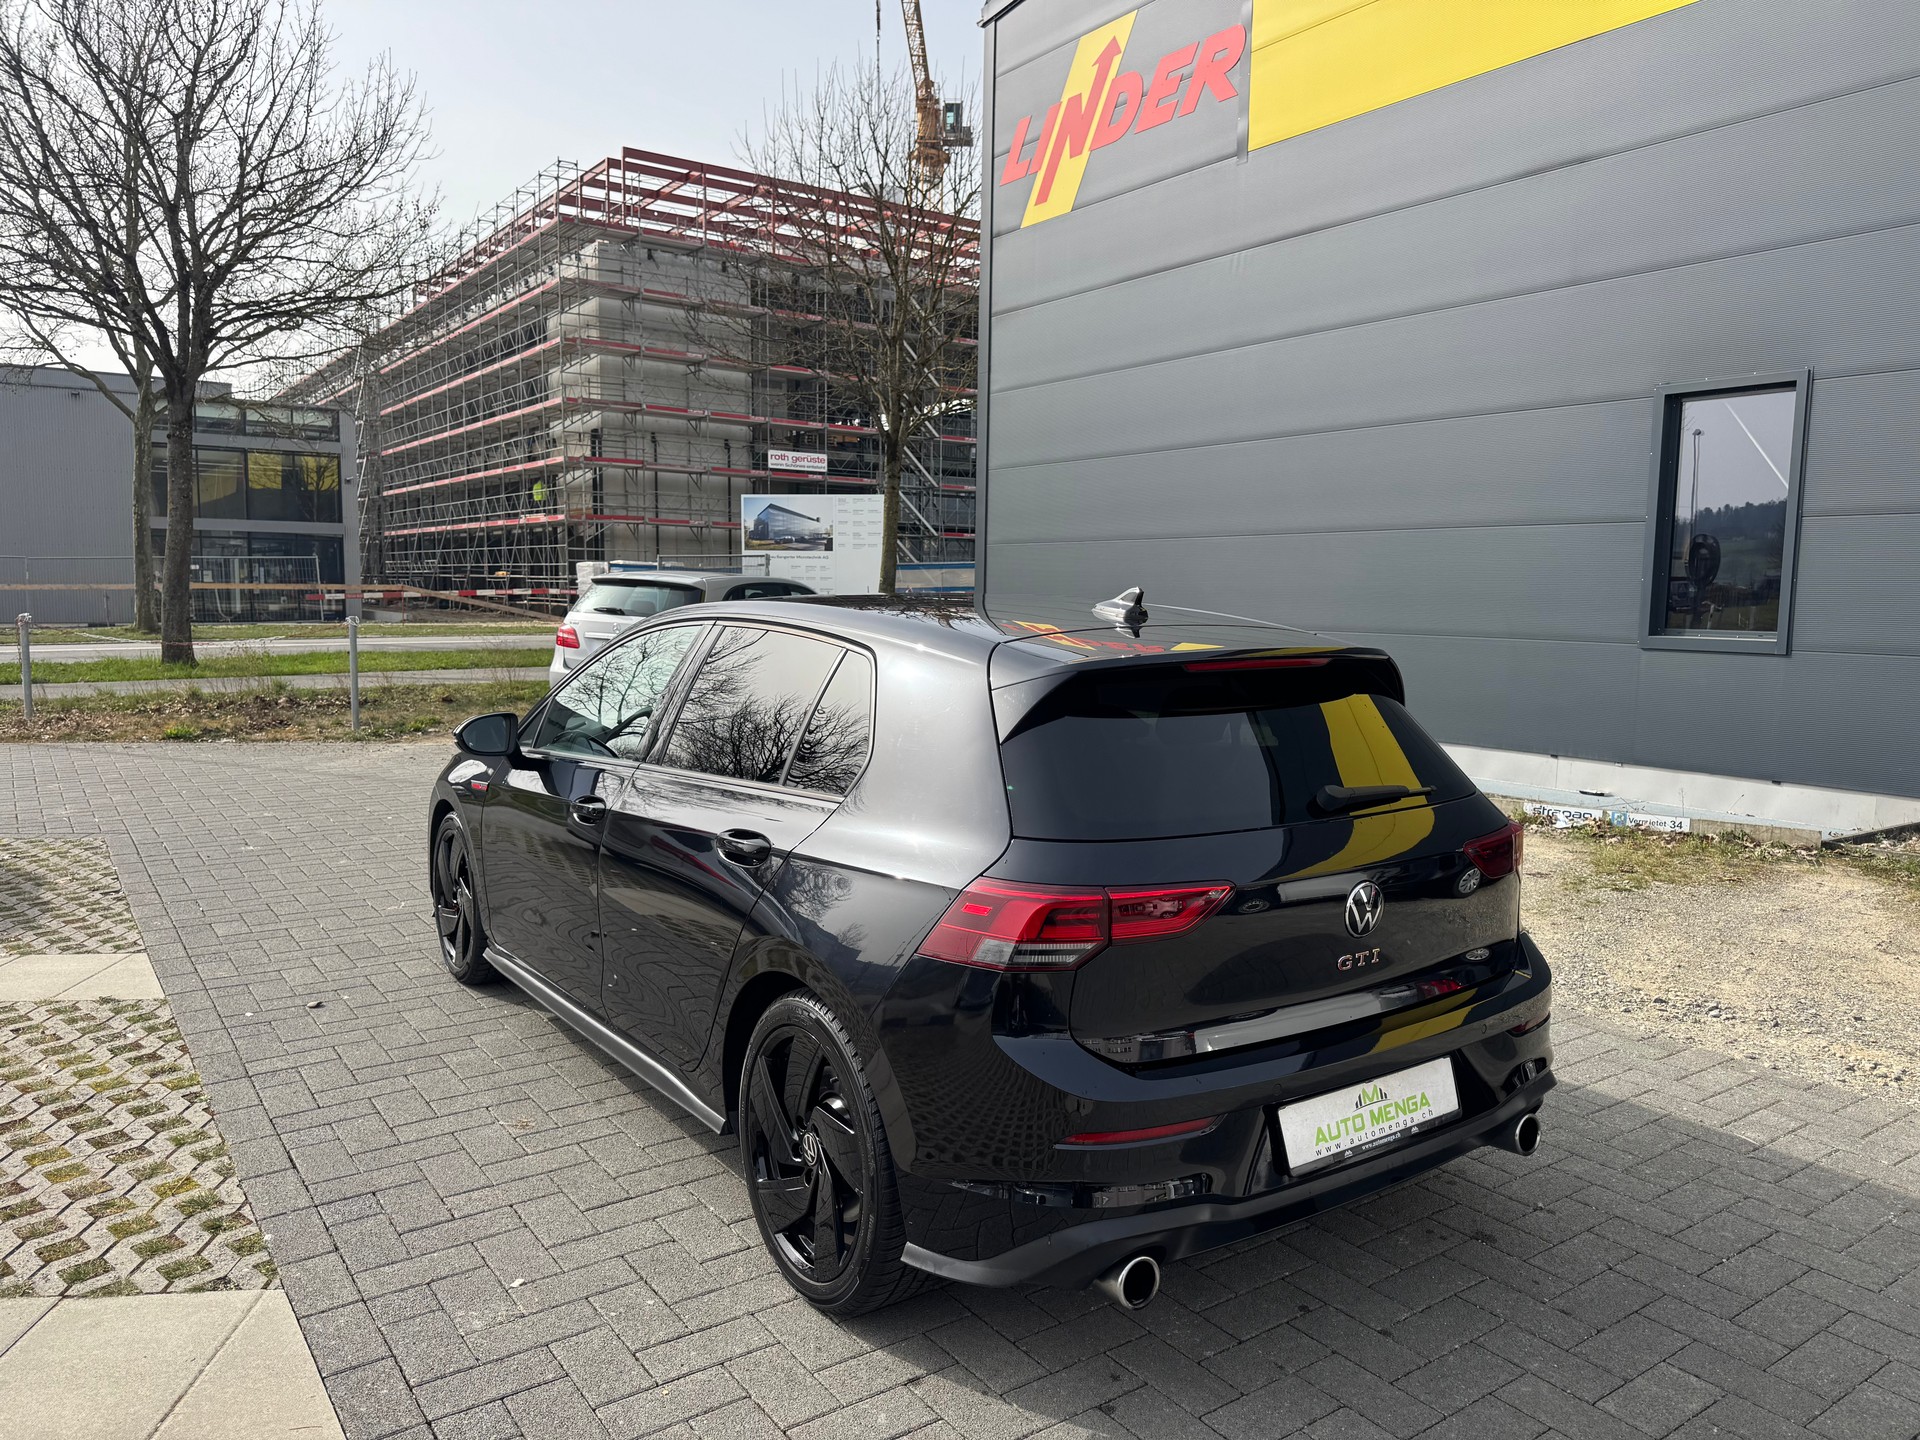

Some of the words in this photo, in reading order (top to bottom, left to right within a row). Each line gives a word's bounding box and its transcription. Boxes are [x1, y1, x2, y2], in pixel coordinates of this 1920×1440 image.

[1000, 24, 1246, 206] LINDER
[770, 453, 789, 461] roth
[791, 455, 826, 464] gerüste
[1669, 820, 1684, 829] 34
[1338, 948, 1380, 971] GTI
[1315, 1113, 1366, 1147] AUTO
[1369, 1091, 1431, 1127] MENGA
[1315, 1108, 1434, 1156] www.automenga.ch
